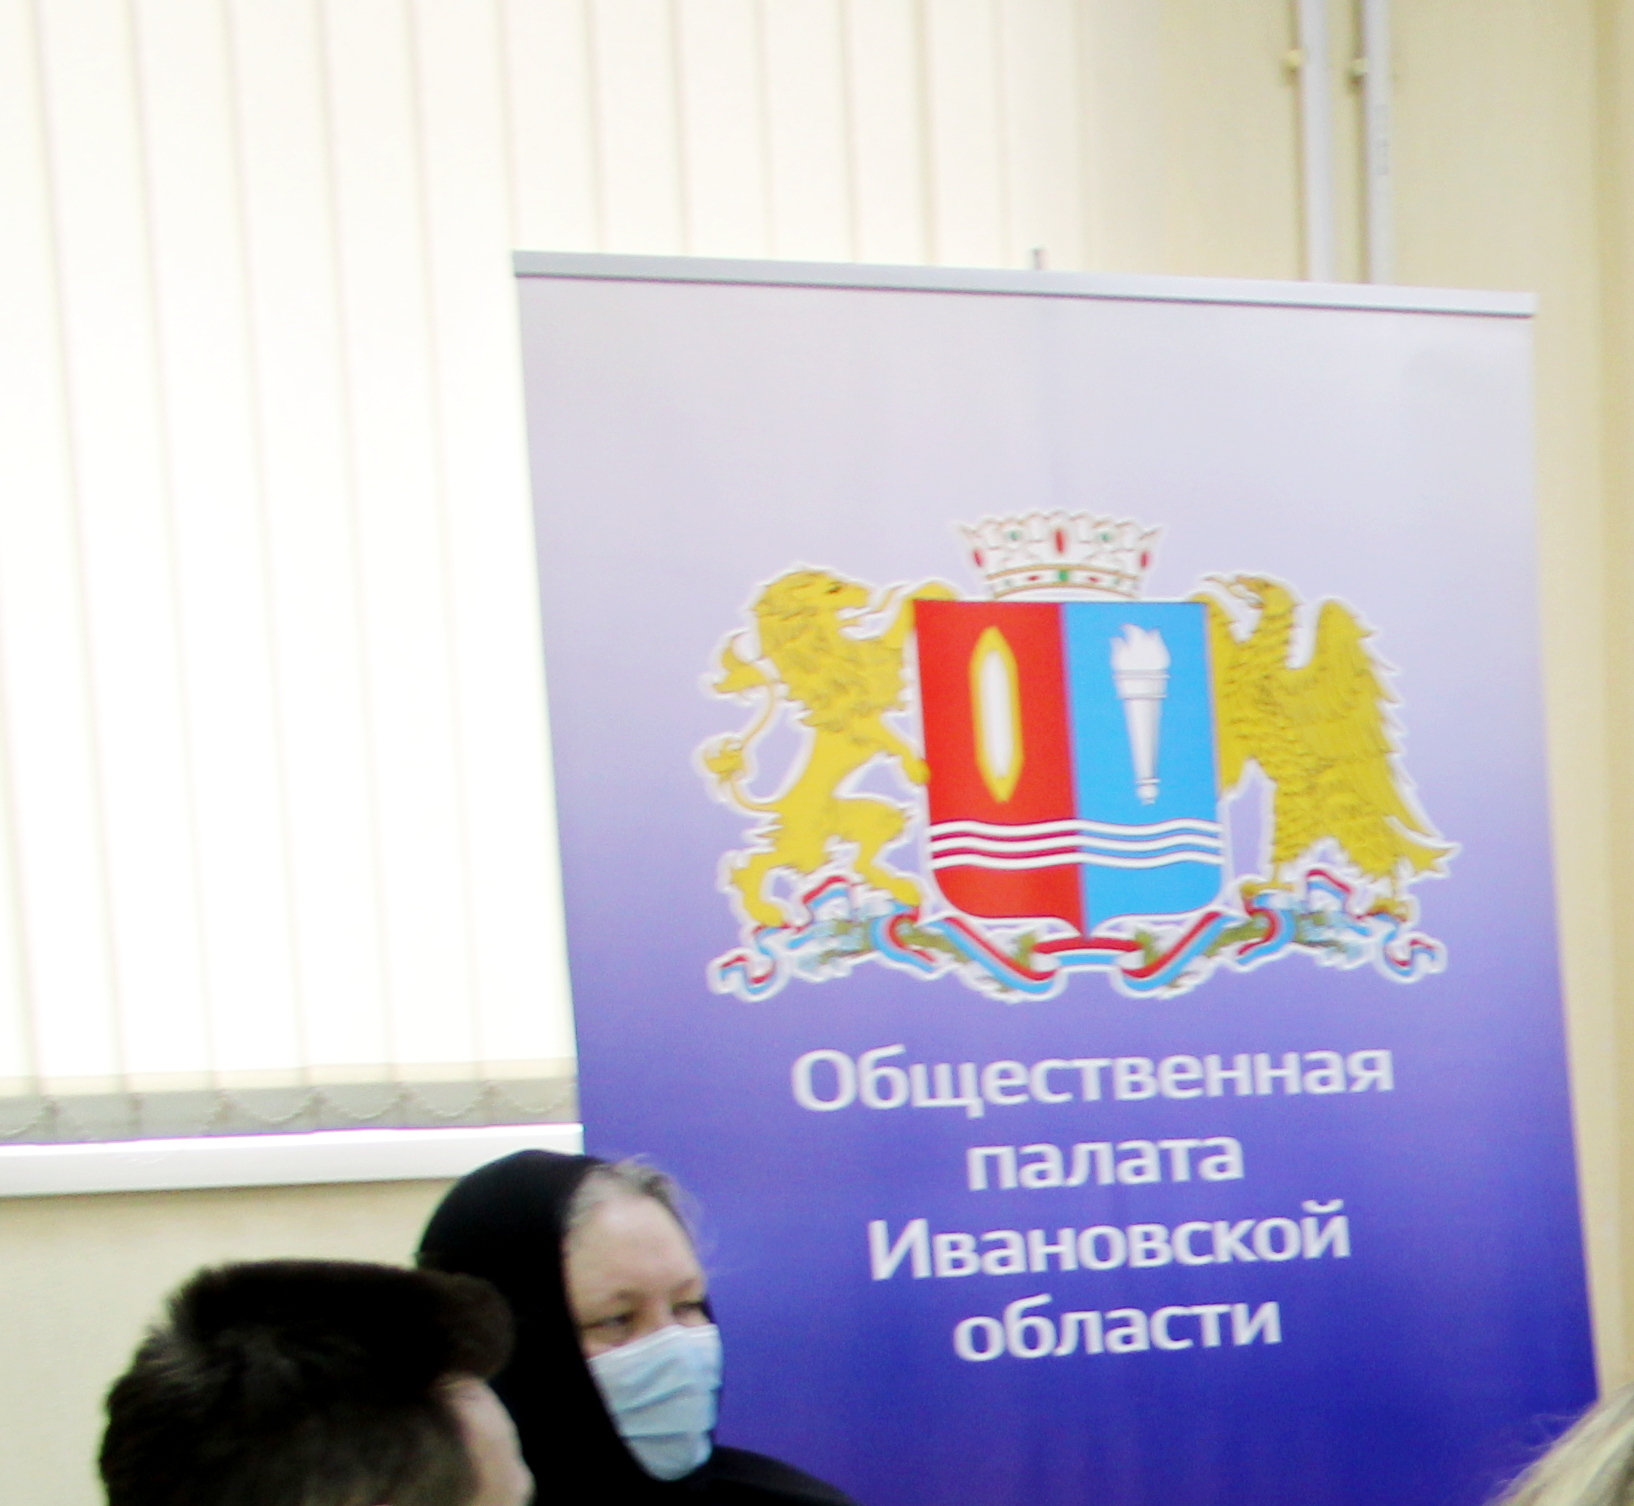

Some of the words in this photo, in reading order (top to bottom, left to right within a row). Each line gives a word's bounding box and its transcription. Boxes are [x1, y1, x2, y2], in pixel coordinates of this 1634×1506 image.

[792, 1043, 1394, 1118] Общественная
[965, 1134, 1246, 1191] палата
[866, 1198, 1351, 1281] Ивановской
[950, 1293, 1283, 1362] области
